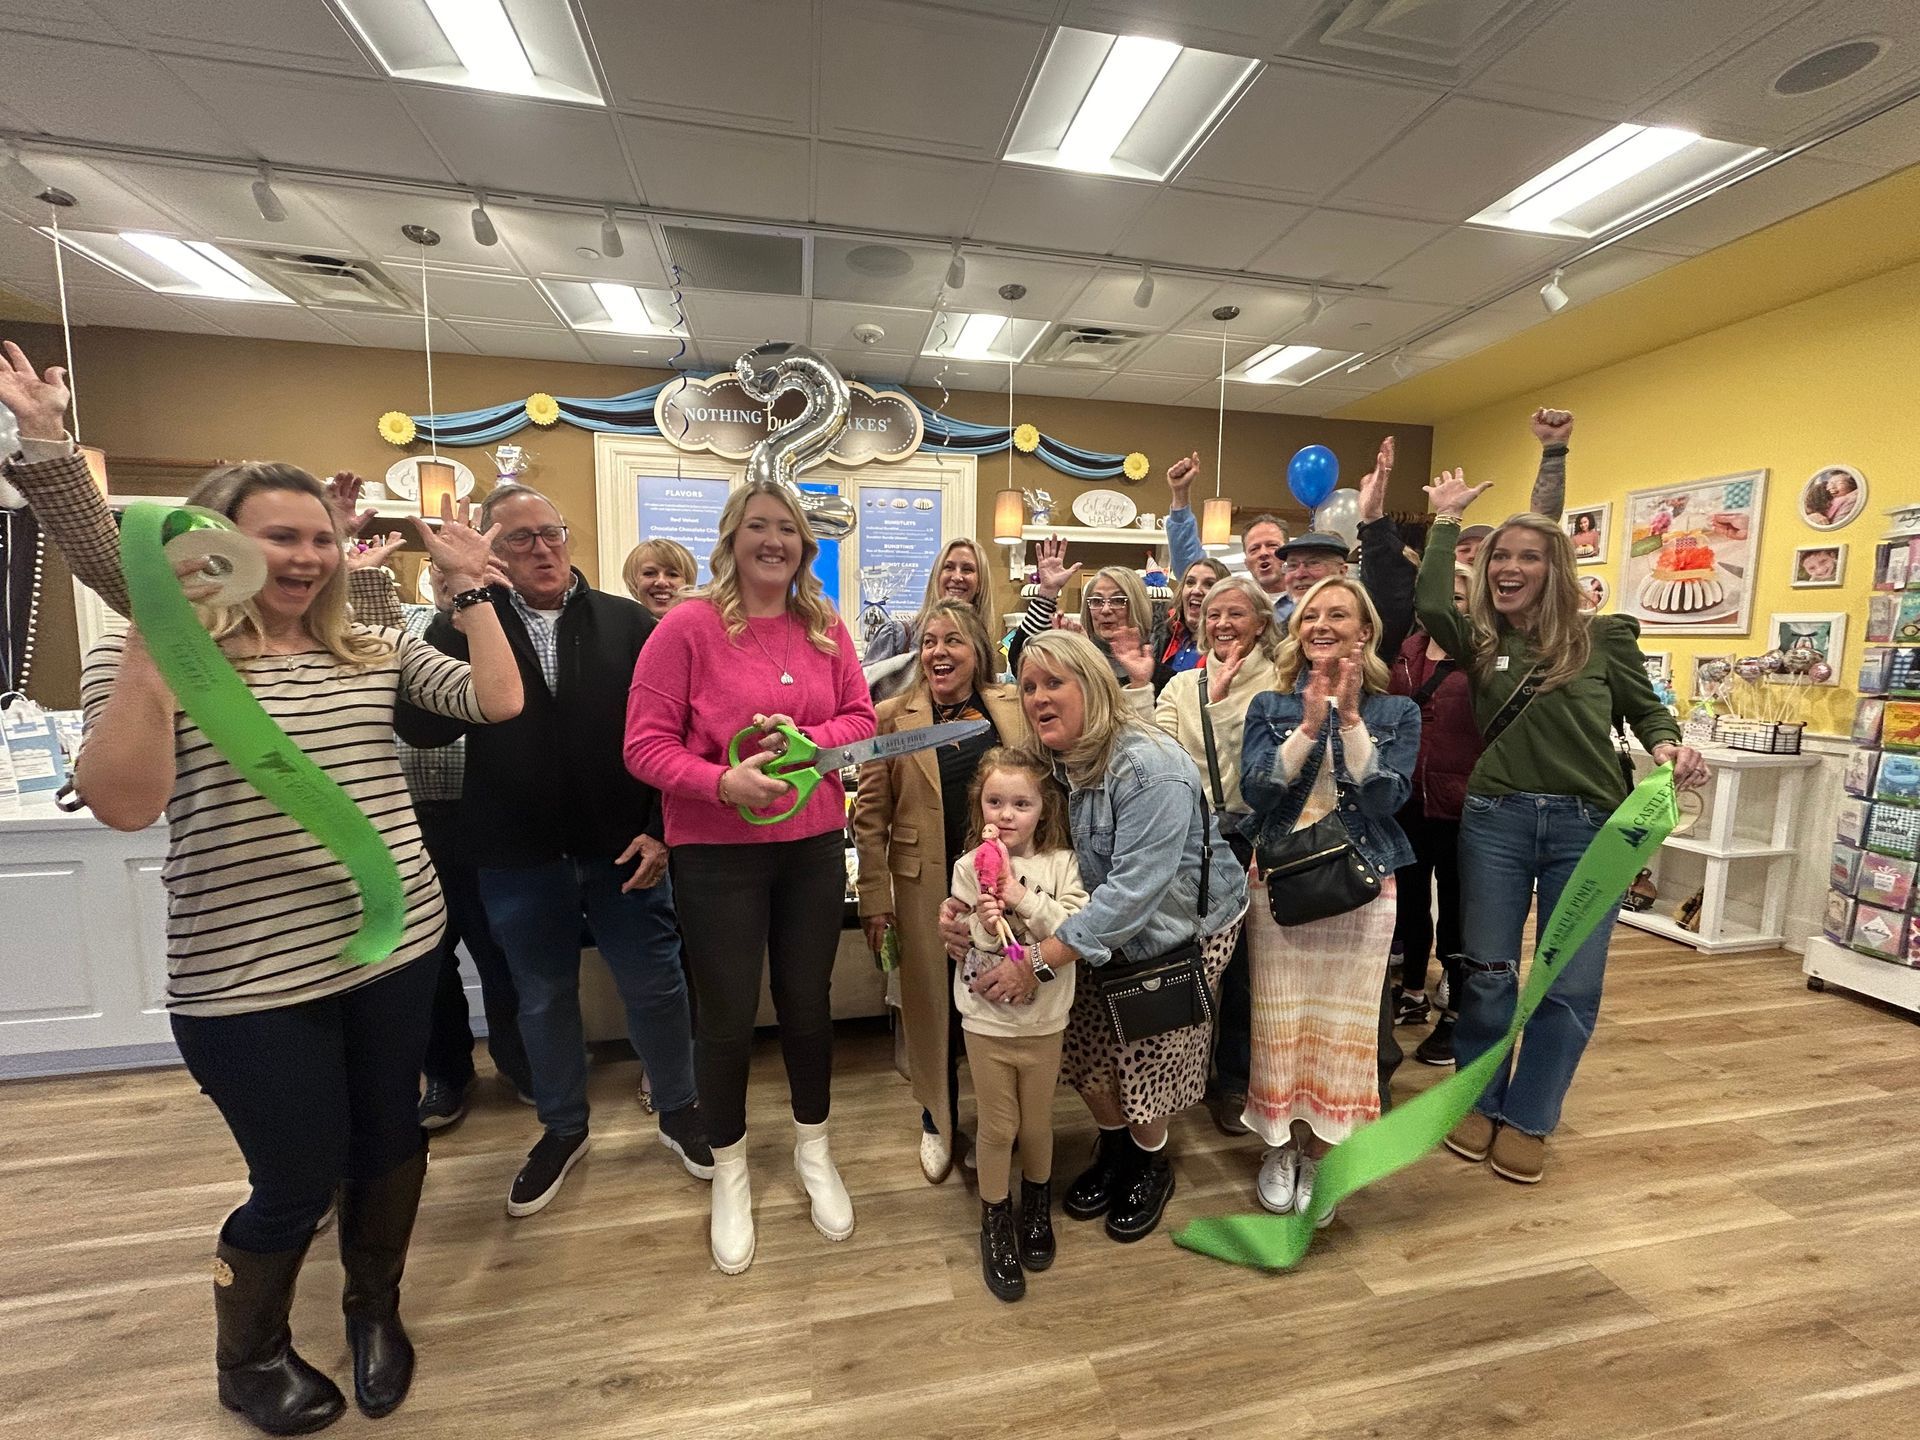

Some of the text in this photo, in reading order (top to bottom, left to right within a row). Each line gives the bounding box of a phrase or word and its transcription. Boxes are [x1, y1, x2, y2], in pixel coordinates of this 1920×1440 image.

[684, 407, 762, 424] NOTHING
[665, 489, 703, 498] FLAVORS
[1088, 515, 1124, 526] HAPPY
[1633, 788, 1670, 826] CASTLE
[1875, 823, 1909, 837] BIRTHDAY
[1548, 908, 1575, 946] CASTLE
[1570, 879, 1597, 909] PINES
